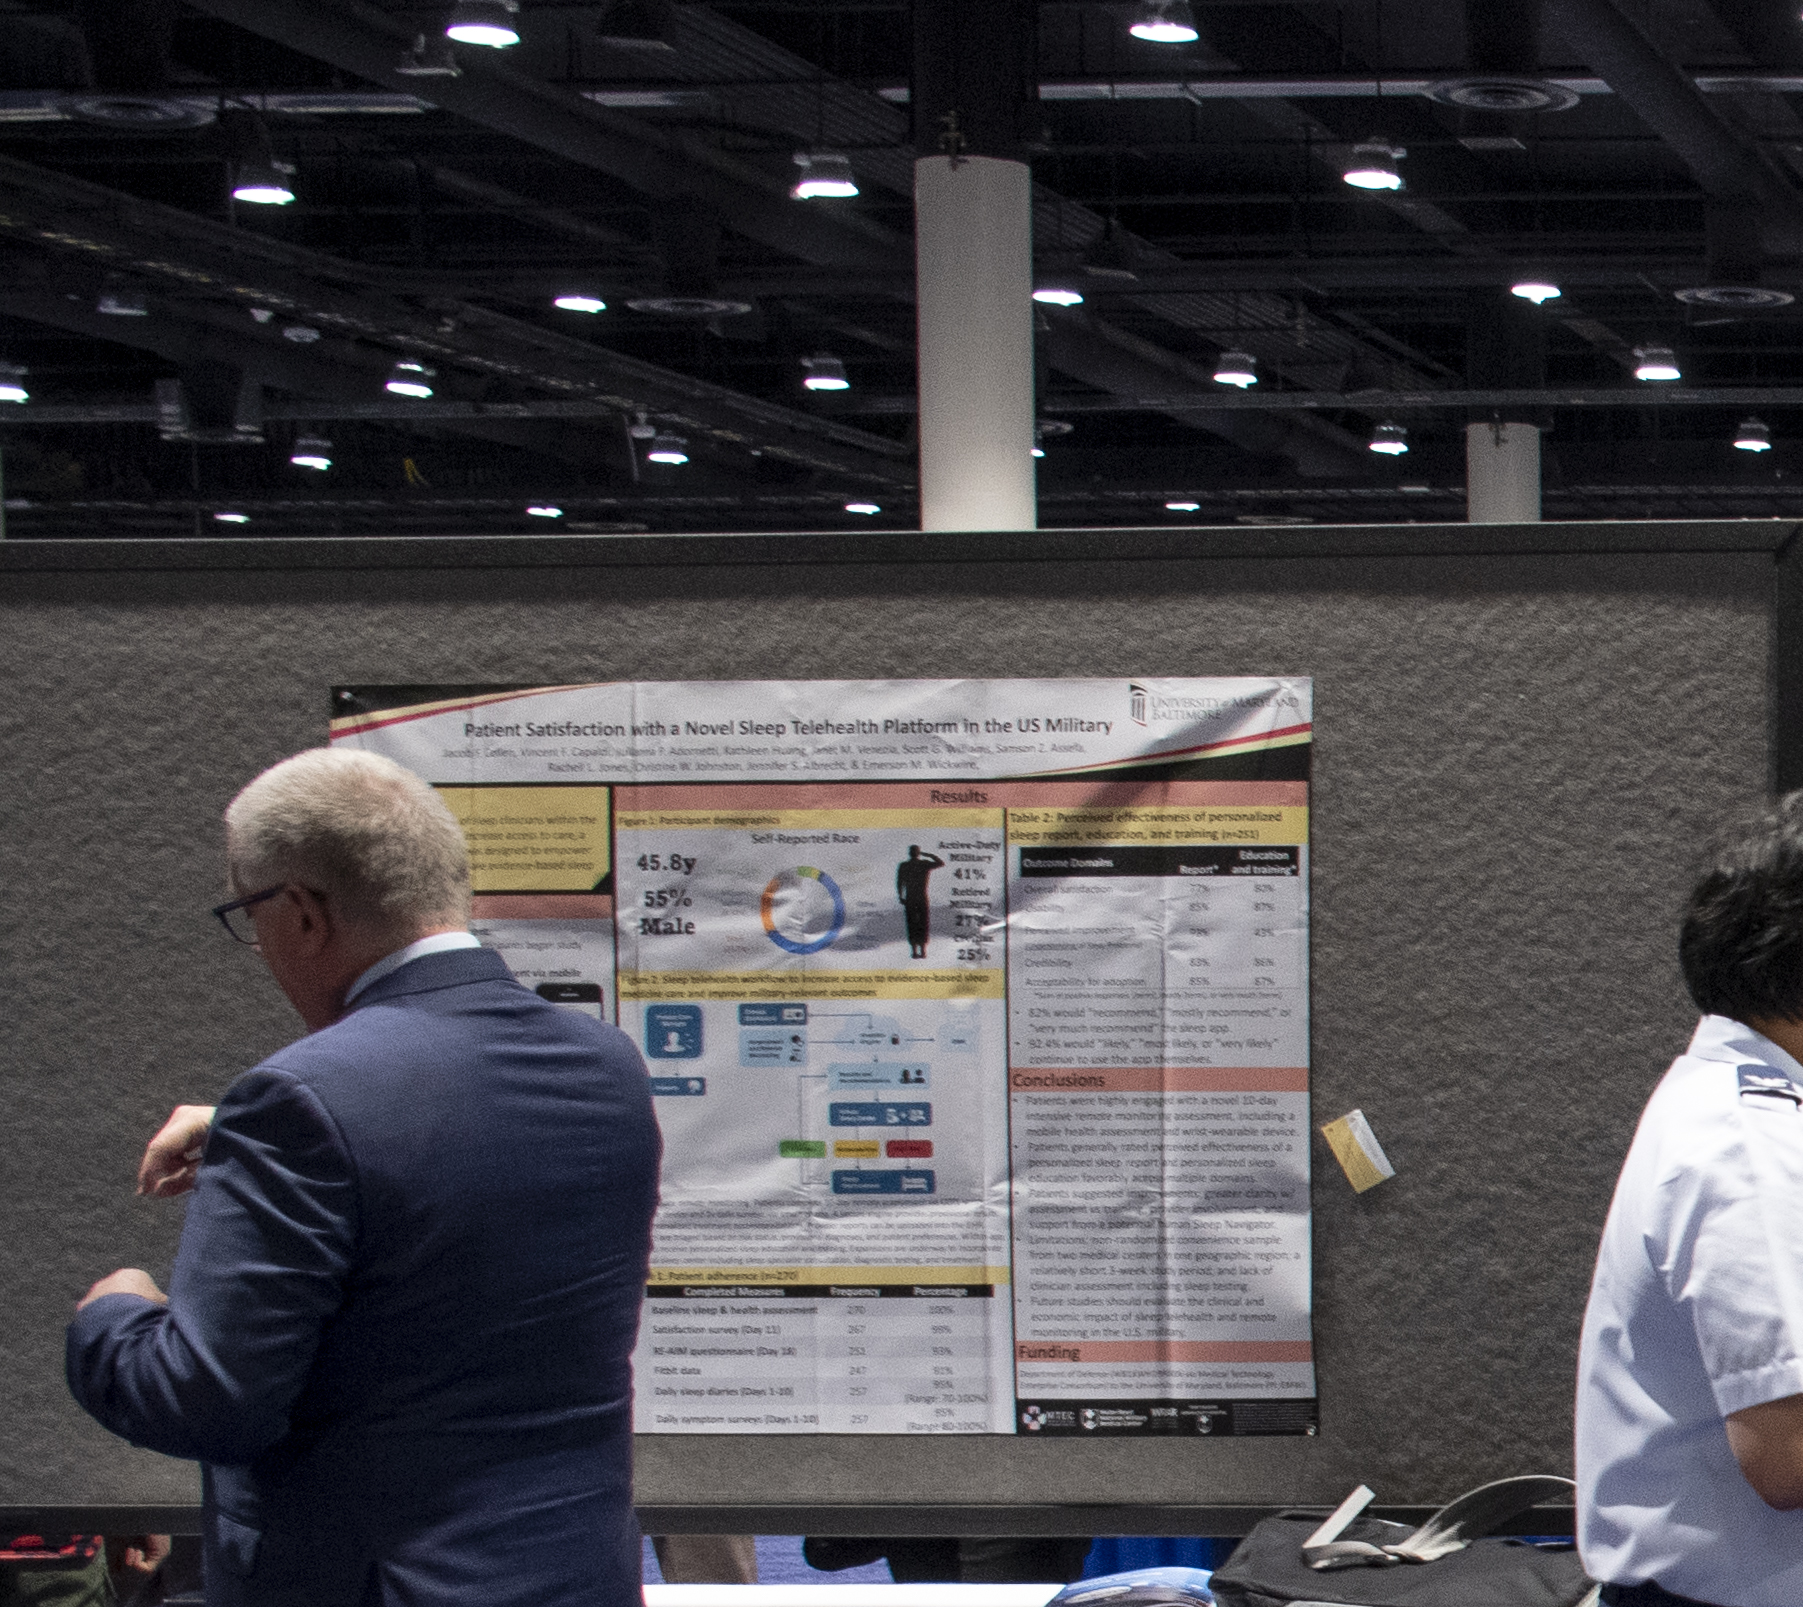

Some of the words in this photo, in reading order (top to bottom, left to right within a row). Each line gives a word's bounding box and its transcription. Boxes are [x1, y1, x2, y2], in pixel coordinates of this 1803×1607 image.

[464, 722, 520, 737] Patient
[526, 721, 625, 737] Satisfaction
[631, 720, 666, 736] with
[671, 724, 680, 736] a
[685, 720, 734, 736] Novel
[739, 720, 786, 739] Sleep
[791, 719, 878, 735] Telehealth
[884, 718, 959, 734] Platform
[963, 718, 979, 733] in
[984, 718, 1012, 733] the
[1017, 717, 1040, 732] US
[1046, 717, 1112, 736] Military
[930, 789, 988, 804] Results
[750, 834, 830, 845] Self-Reported
[832, 833, 860, 843] Race
[938, 841, 1001, 852] Active-Duty
[637, 854, 697, 875] 45.8y
[954, 868, 987, 880] 41%
[644, 889, 693, 909] 55%
[639, 917, 695, 935] Male
[957, 948, 991, 961] 25%
[1011, 1073, 1105, 1088] Conclusions
[1019, 1344, 1081, 1361] Funding
